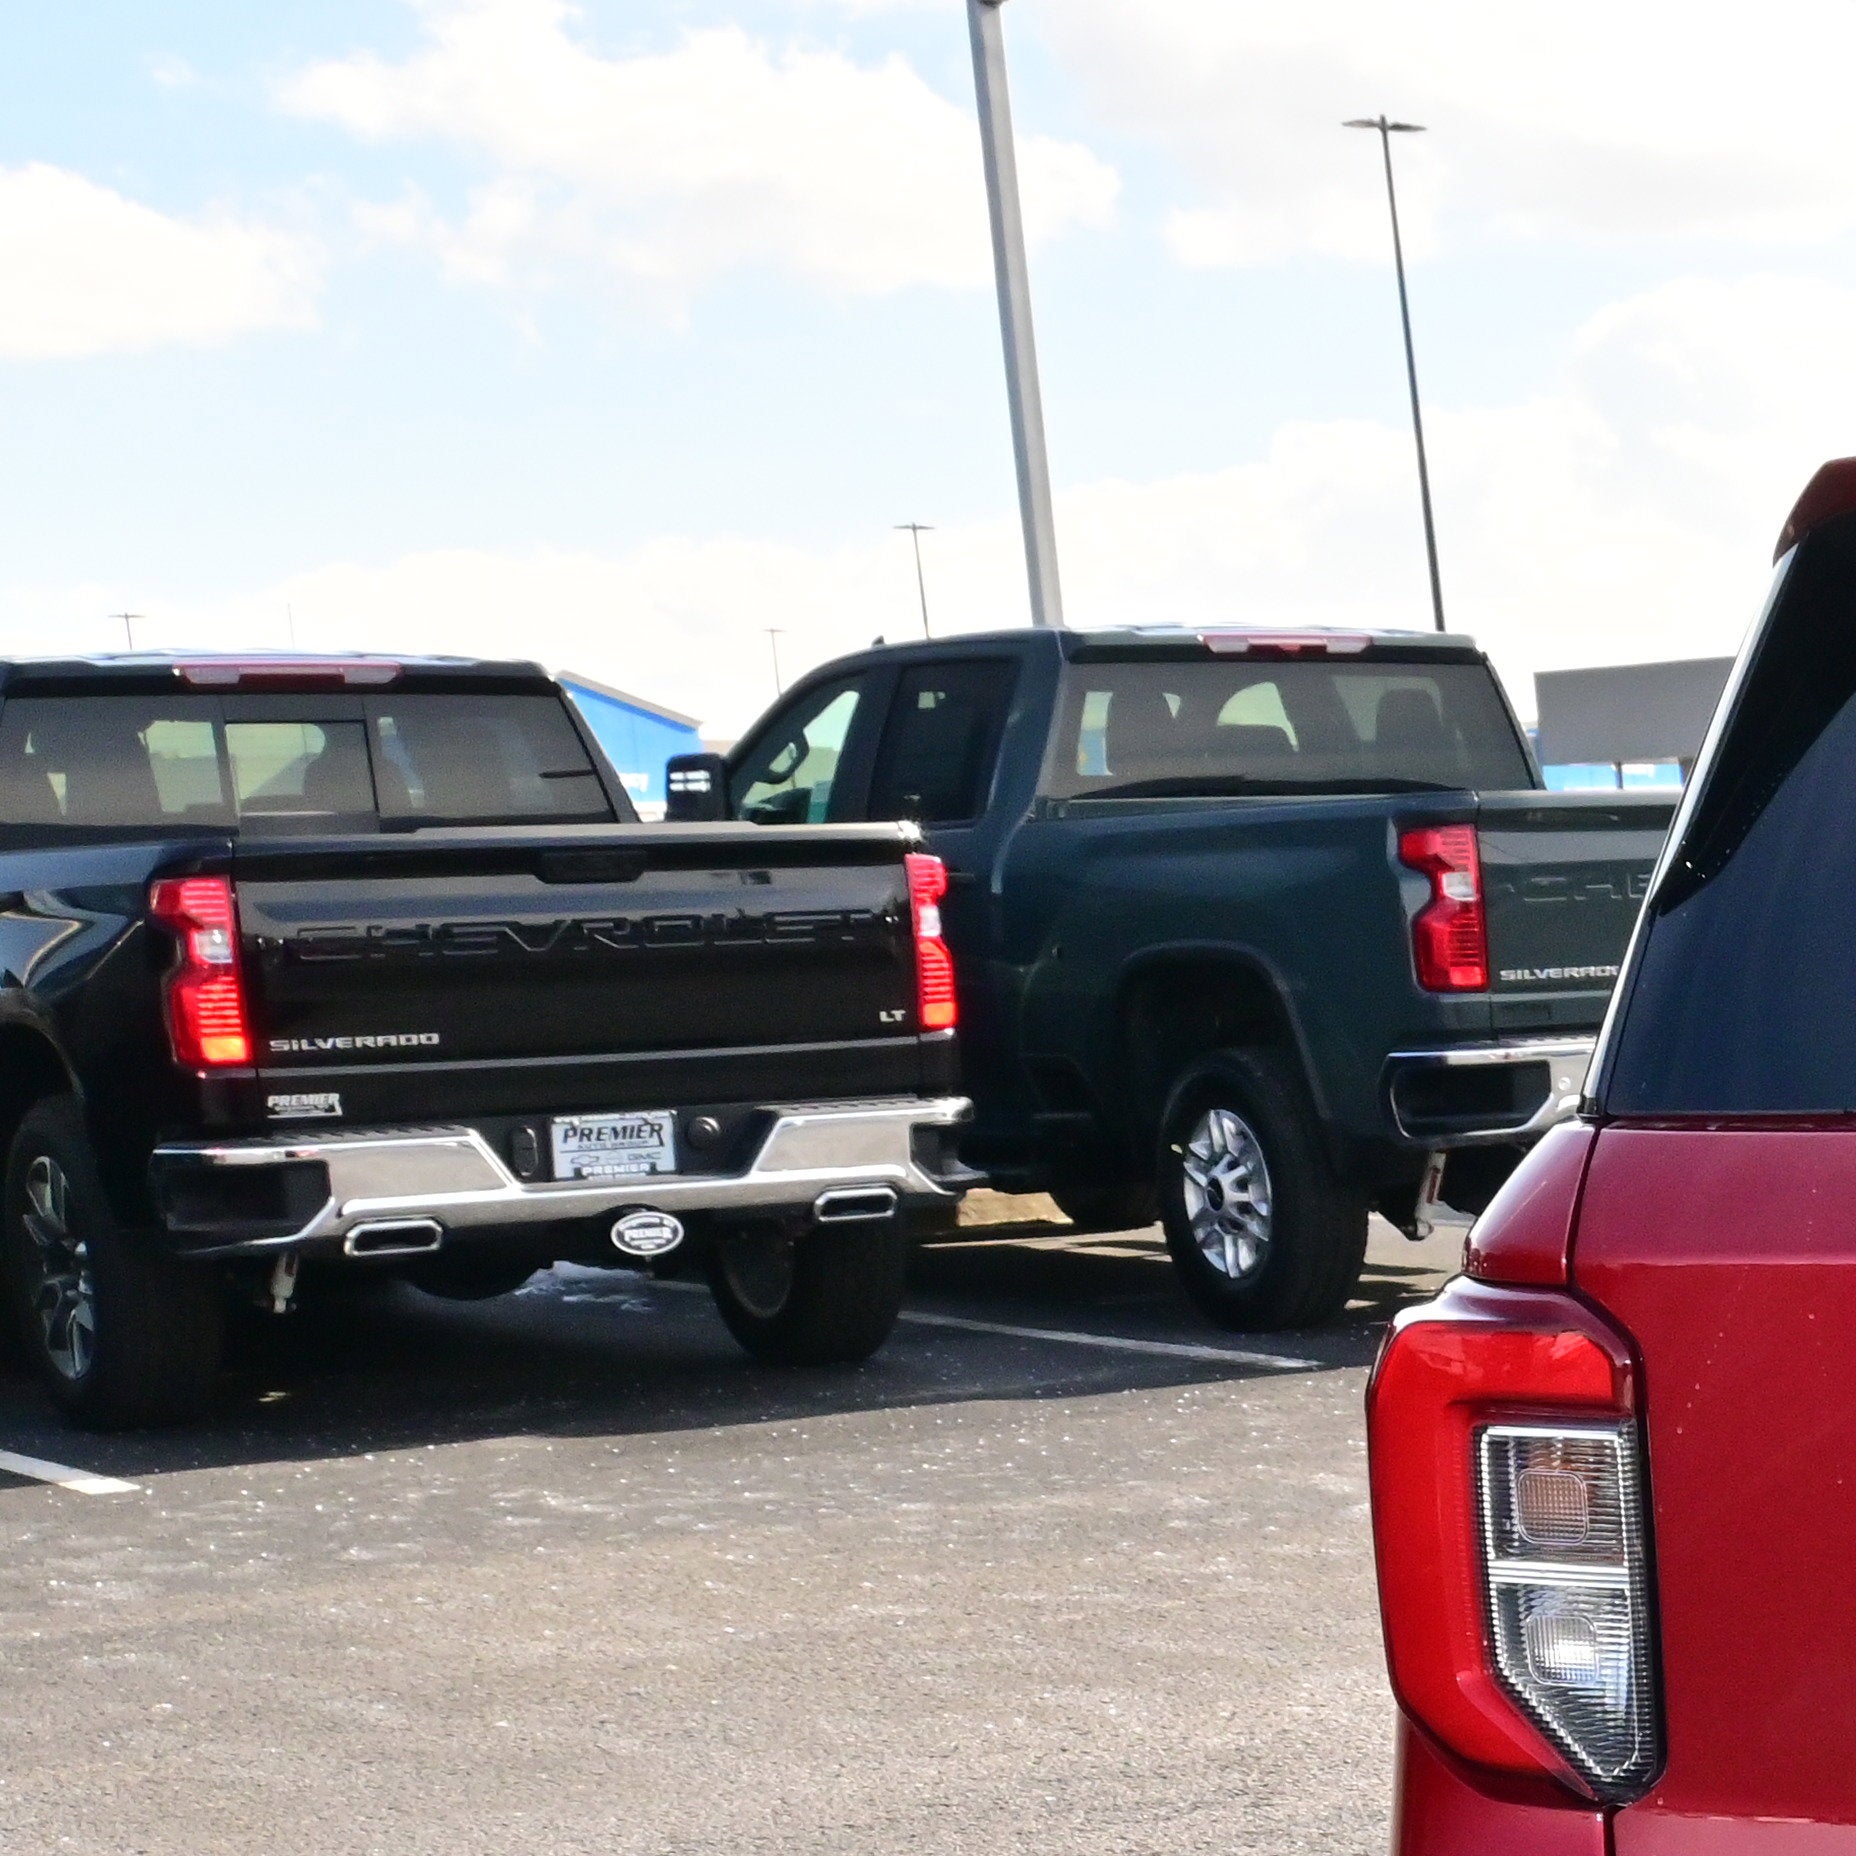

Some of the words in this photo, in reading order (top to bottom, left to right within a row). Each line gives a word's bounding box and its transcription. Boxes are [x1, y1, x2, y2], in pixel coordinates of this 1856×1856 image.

[297, 909, 875, 960] CHEVROLET
[880, 1009, 906, 1022] LT
[269, 1033, 440, 1051] SILVERADO
[267, 1093, 341, 1110] PREMIER
[563, 1123, 664, 1146] PREMIER
[582, 1163, 650, 1176] PREMIER
